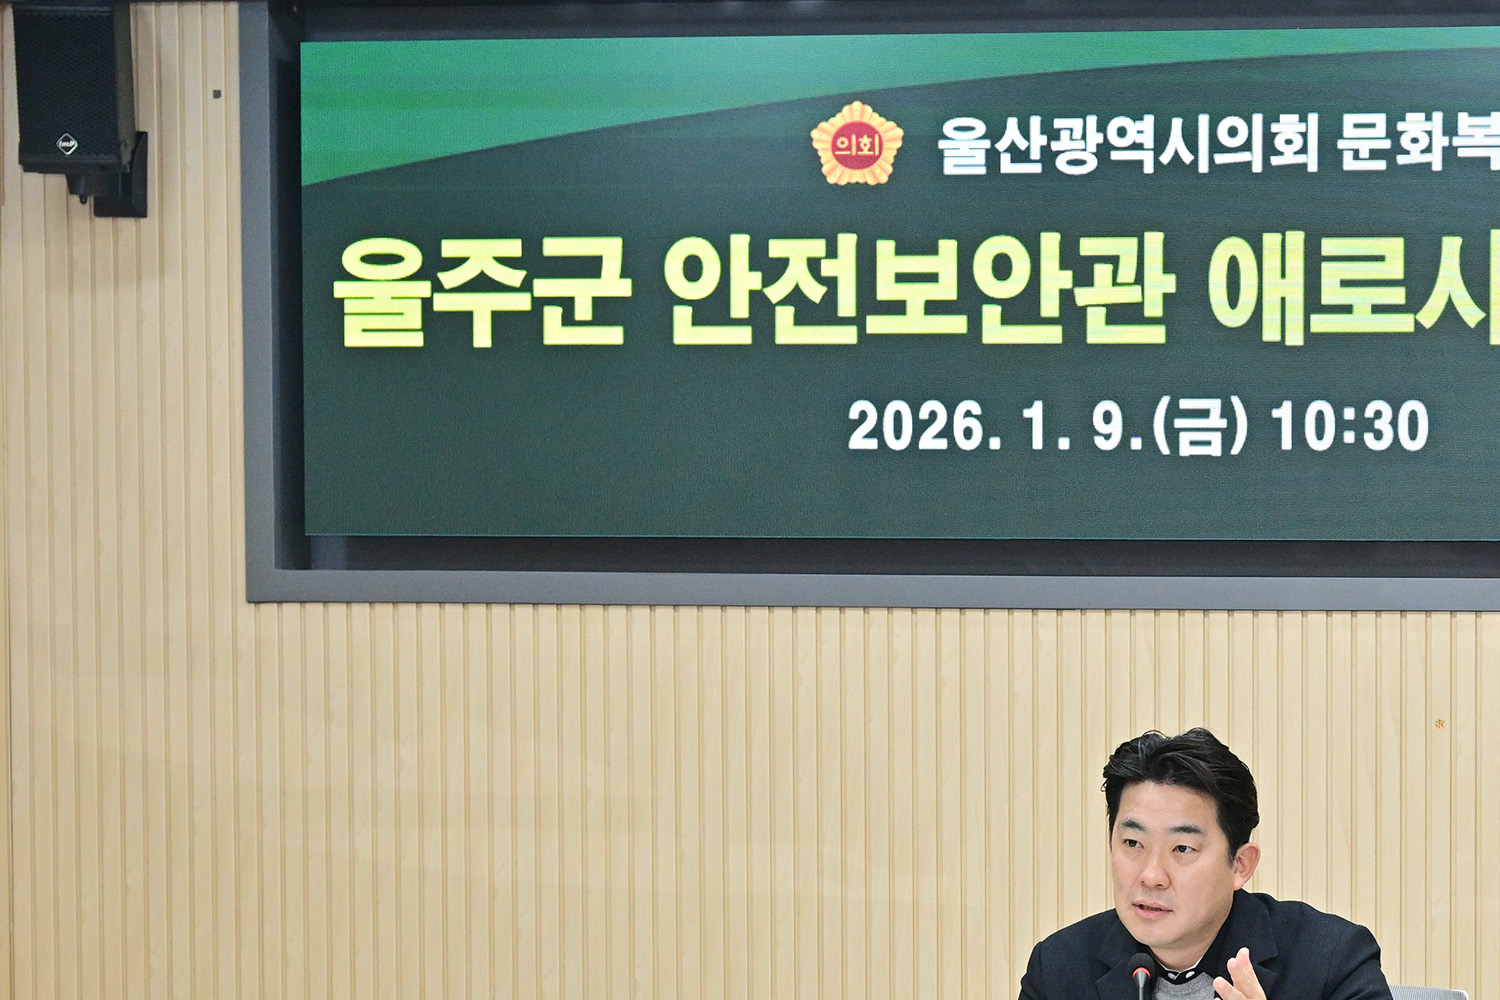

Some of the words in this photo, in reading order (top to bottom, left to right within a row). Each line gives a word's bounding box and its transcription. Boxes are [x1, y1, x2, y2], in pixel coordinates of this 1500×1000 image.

[834, 134, 879, 155] 의회
[938, 113, 1320, 177] 울산광역시의회
[333, 238, 633, 349] 울주군
[665, 232, 1177, 347] 안전보안관
[848, 400, 1002, 452] 2026.
[1023, 401, 1071, 452] 1.
[1093, 396, 1249, 458] 9.(금)
[1272, 400, 1431, 453] 10:30
